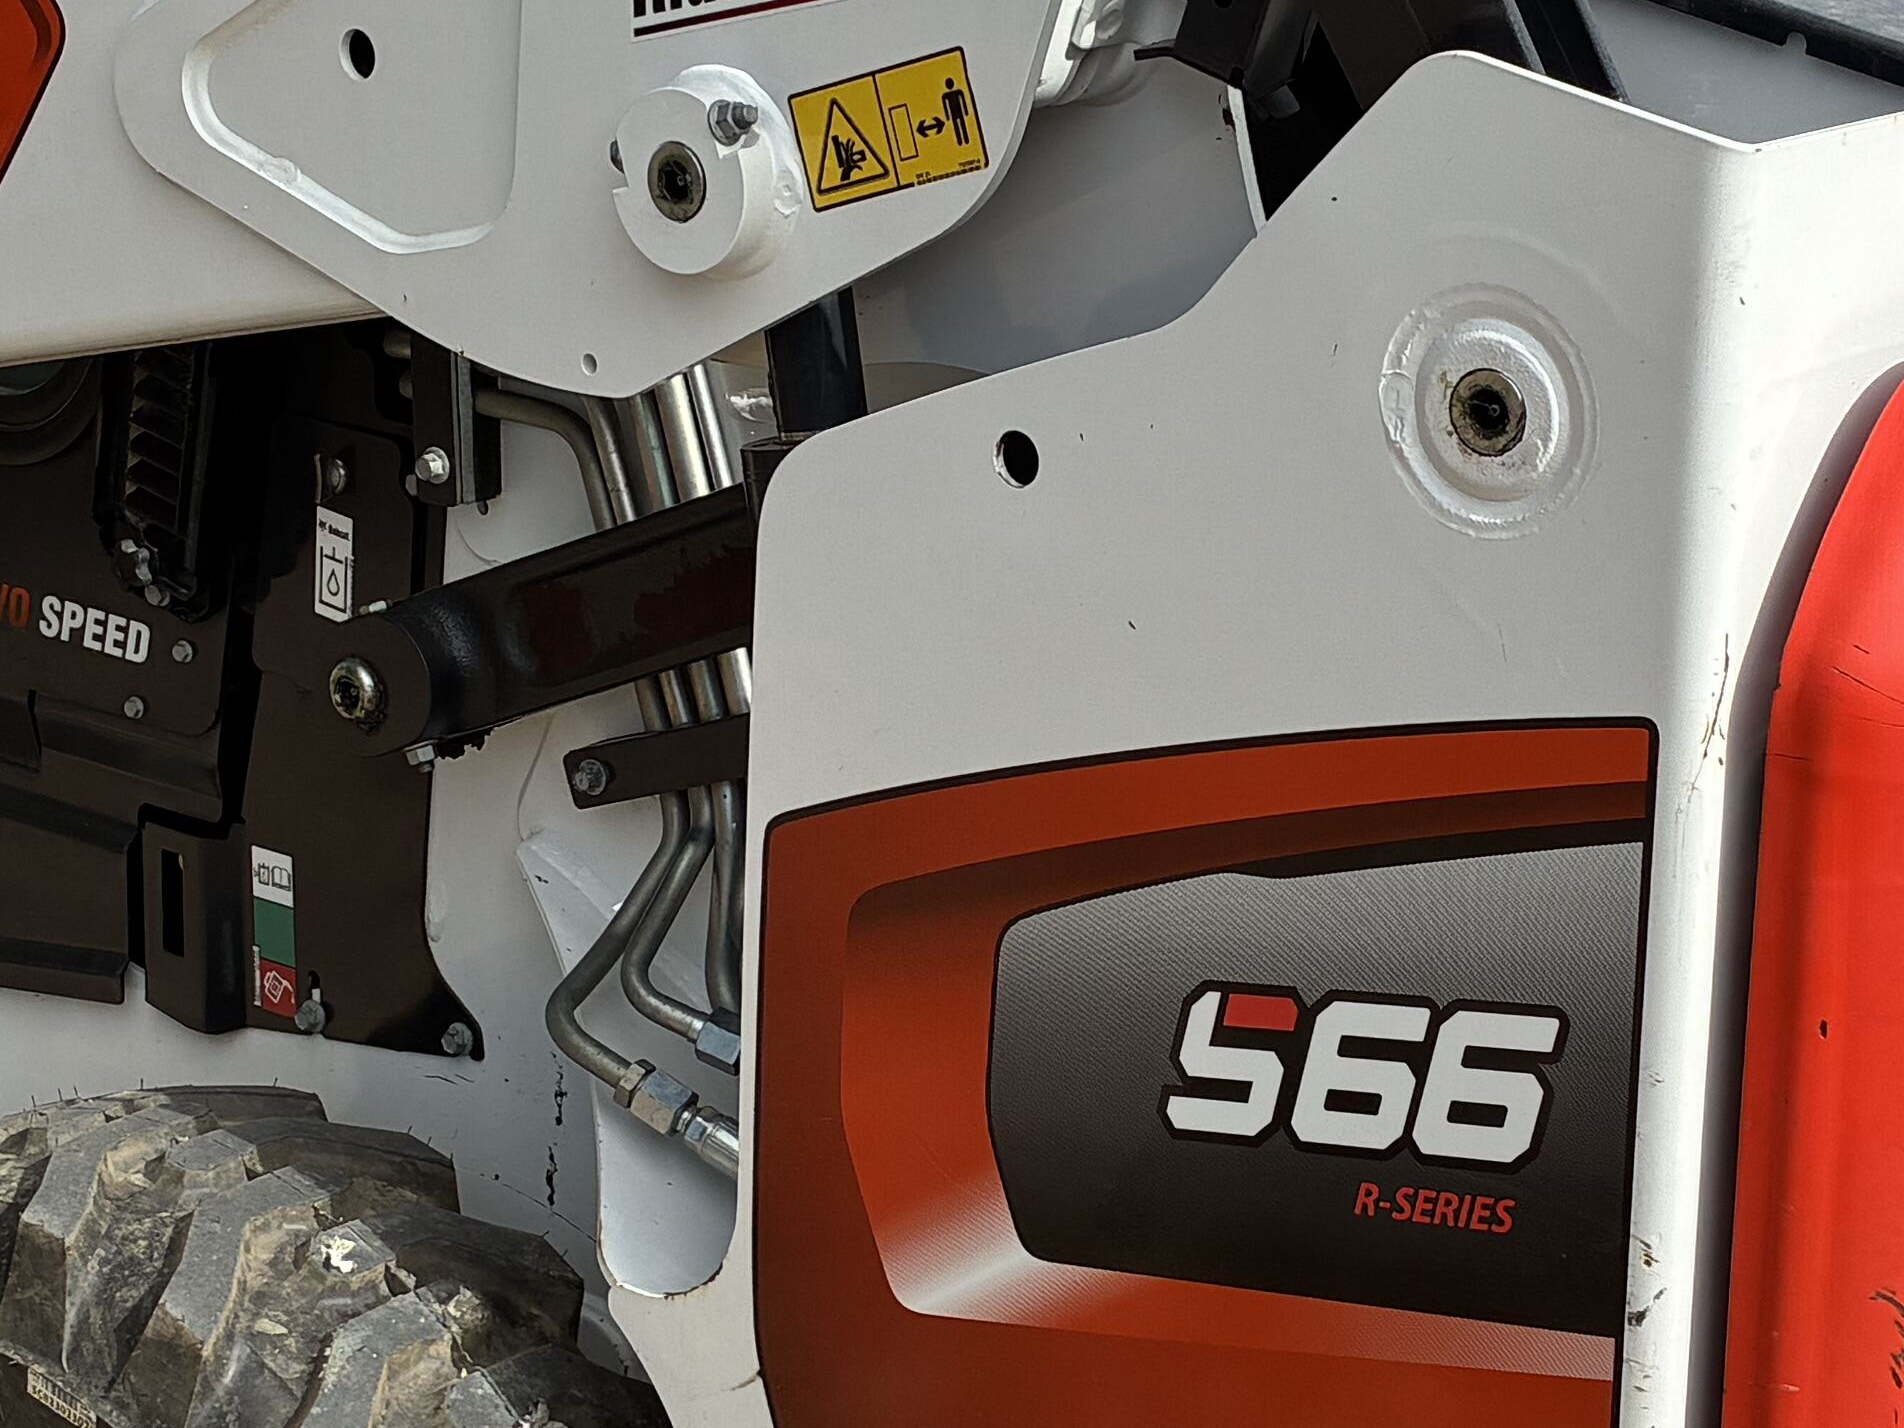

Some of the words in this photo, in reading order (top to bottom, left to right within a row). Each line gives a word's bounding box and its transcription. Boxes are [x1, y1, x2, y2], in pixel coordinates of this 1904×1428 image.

[38, 594, 152, 664] SPEED
[1165, 989, 1561, 1165] S66
[1352, 1181, 1518, 1235] R-SERIES
